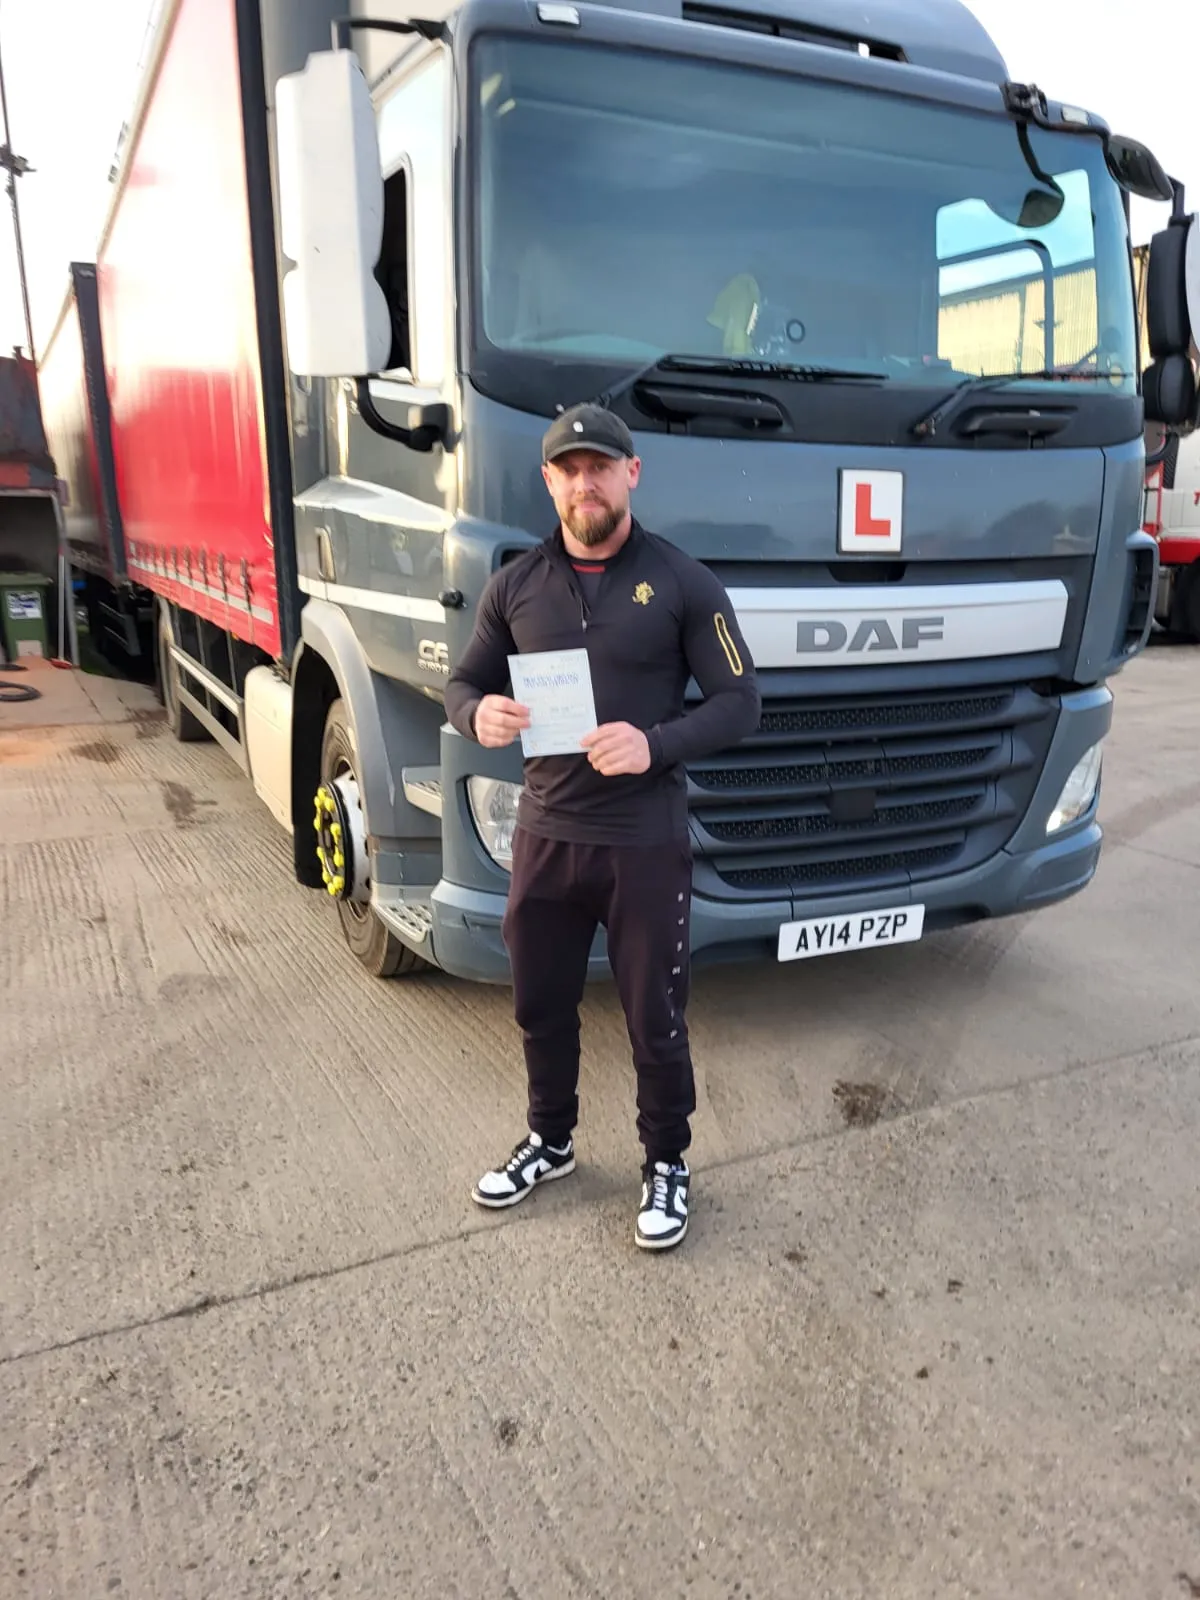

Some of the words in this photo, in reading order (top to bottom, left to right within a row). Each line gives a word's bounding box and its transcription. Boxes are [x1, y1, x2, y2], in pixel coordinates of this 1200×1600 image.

[855, 483, 891, 536] L
[419, 640, 448, 661] CF
[797, 617, 944, 653] DAF
[796, 922, 850, 952] AY14
[859, 914, 907, 942] PZP
